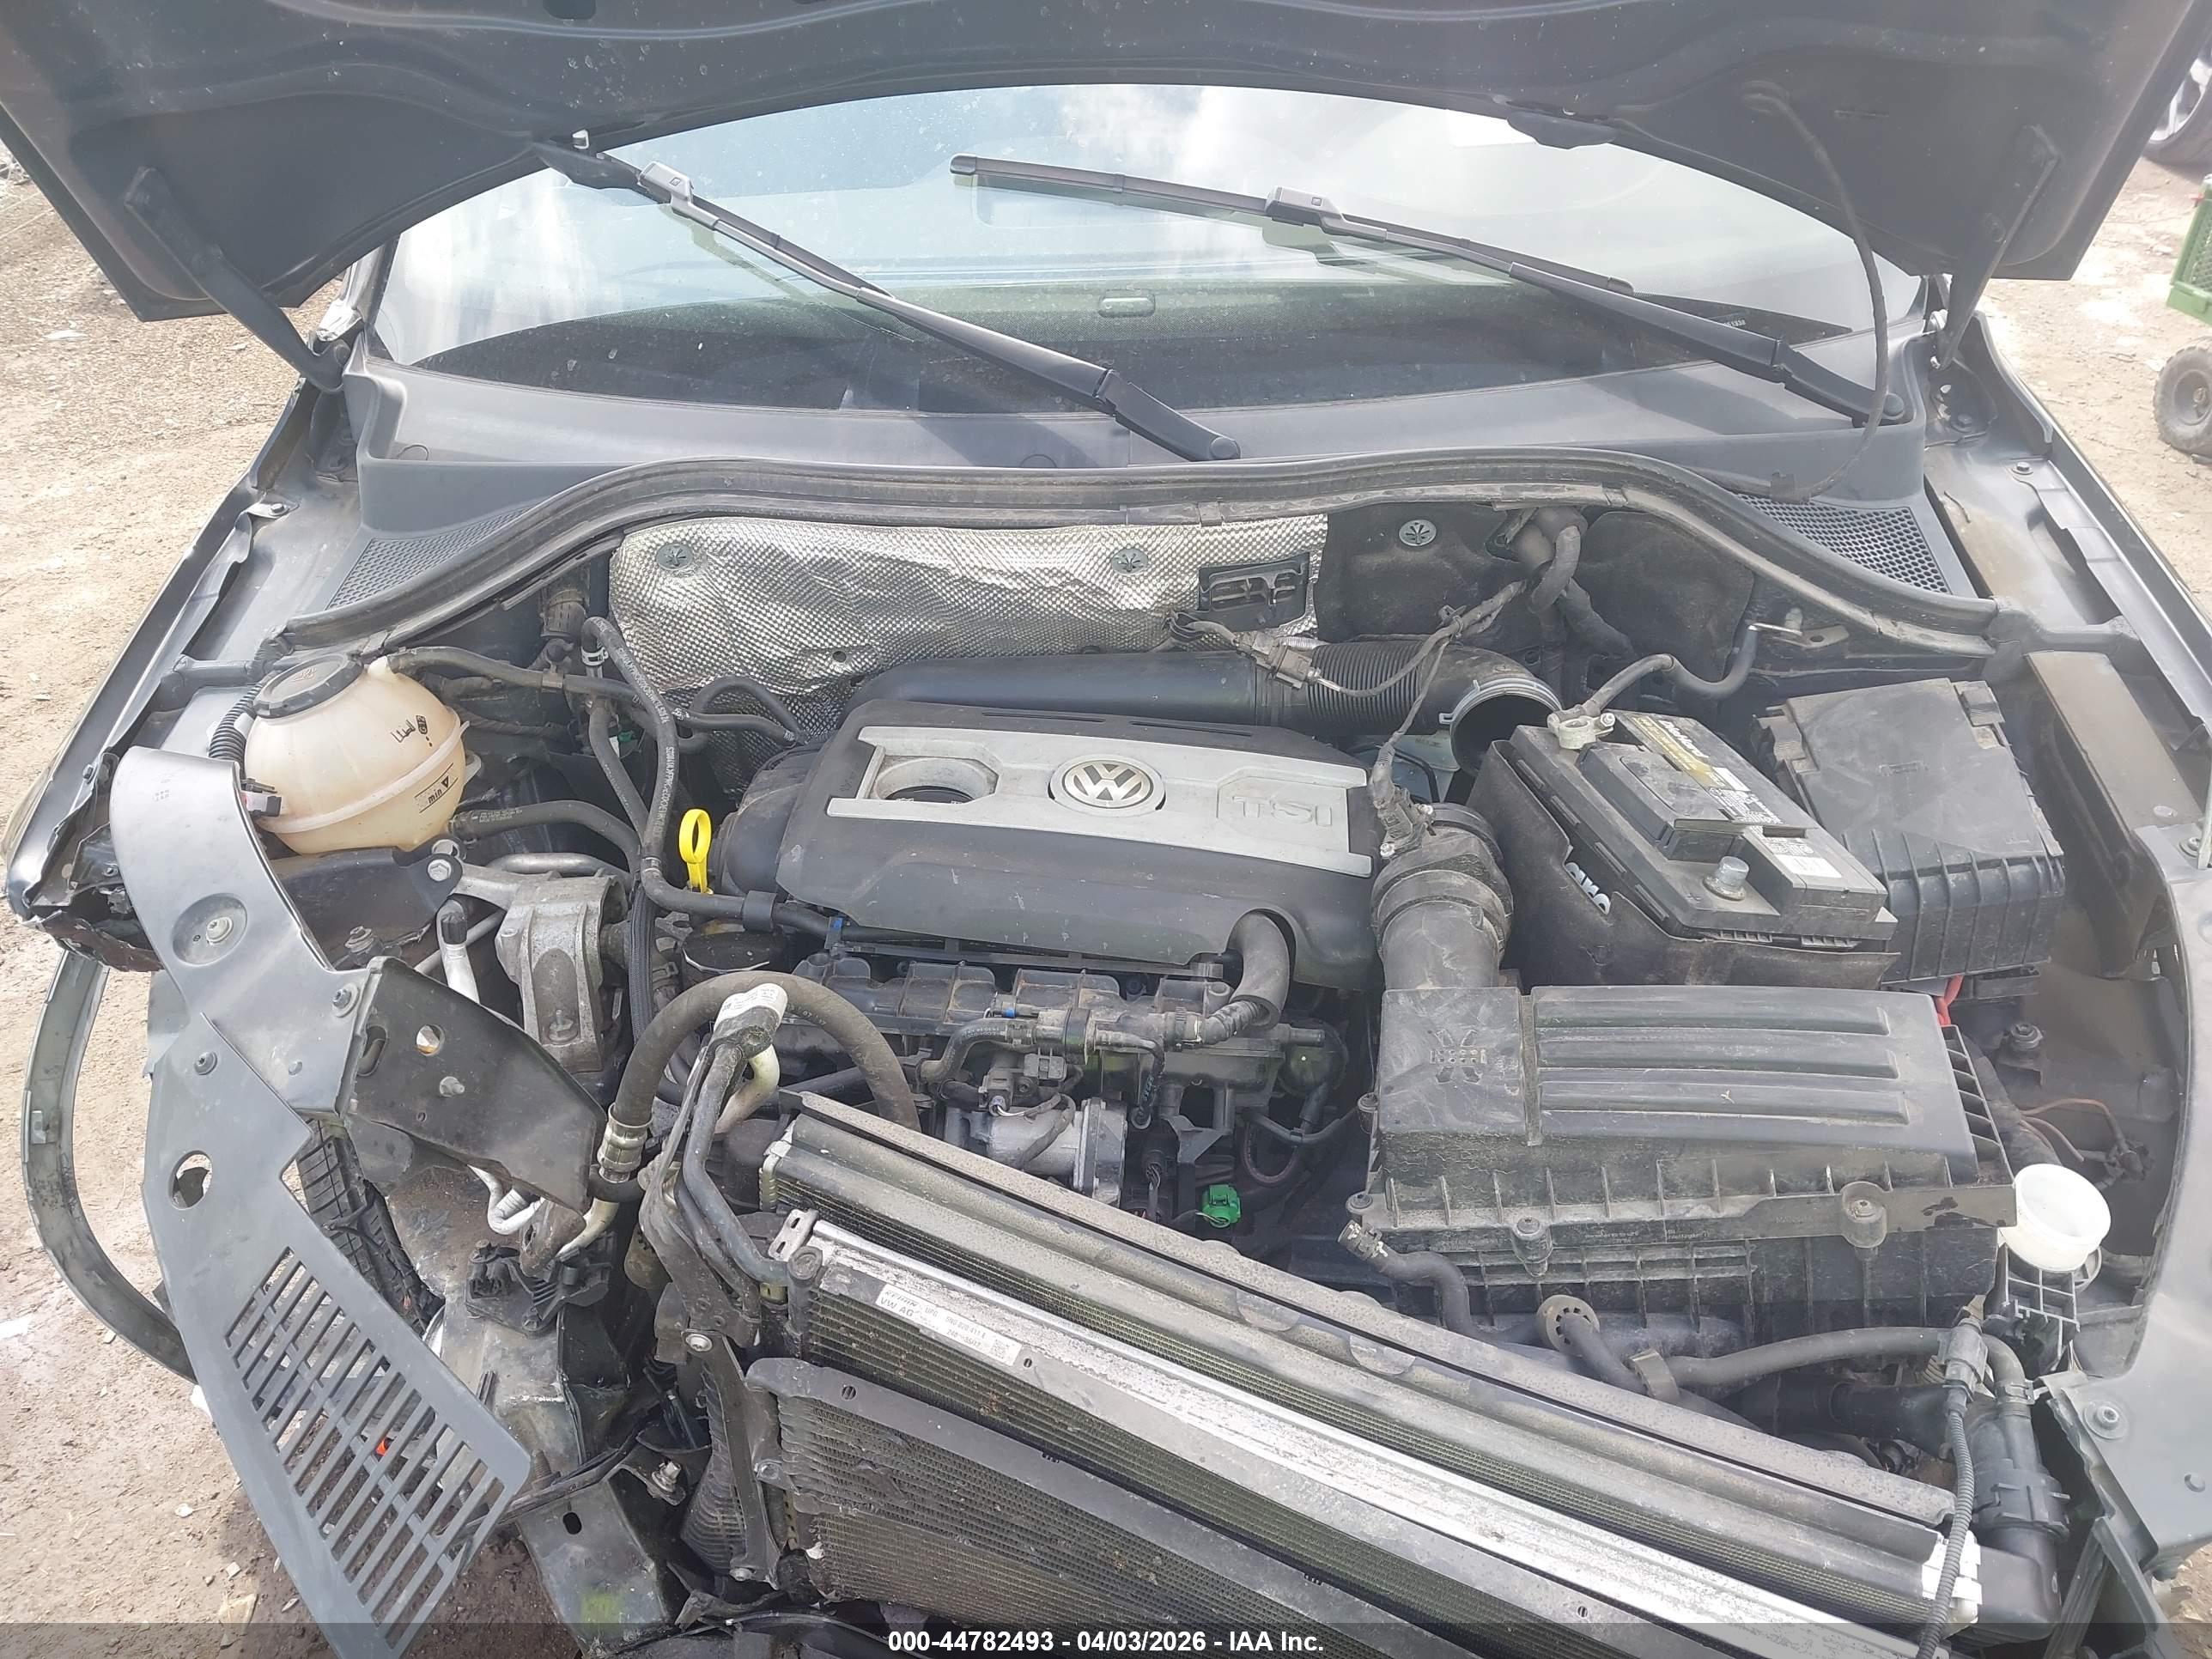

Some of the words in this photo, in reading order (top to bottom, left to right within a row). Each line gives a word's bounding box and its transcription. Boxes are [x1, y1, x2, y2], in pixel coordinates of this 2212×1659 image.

[428, 788, 443, 804] min
[1065, 760, 1151, 809] VW
[1232, 796, 1333, 827] TSI
[880, 1297, 897, 1310] VW
[899, 1305, 915, 1318] AG
